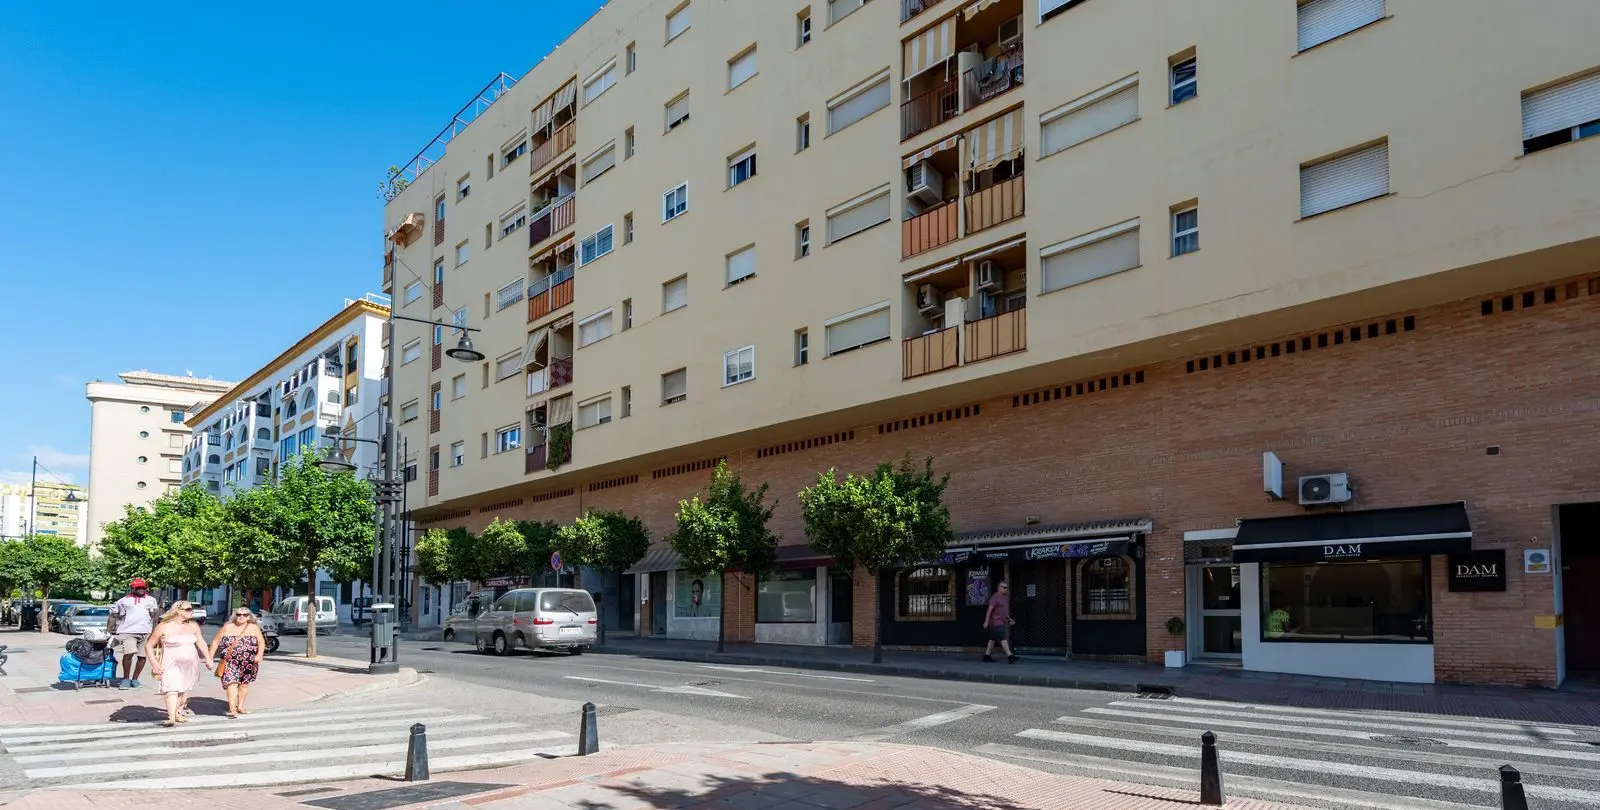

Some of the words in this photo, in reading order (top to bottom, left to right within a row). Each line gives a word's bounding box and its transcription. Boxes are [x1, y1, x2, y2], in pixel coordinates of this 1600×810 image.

[1031, 546, 1060, 558] KRAKEN
[1324, 544, 1361, 555] DAM
[1456, 564, 1497, 575] DAM
